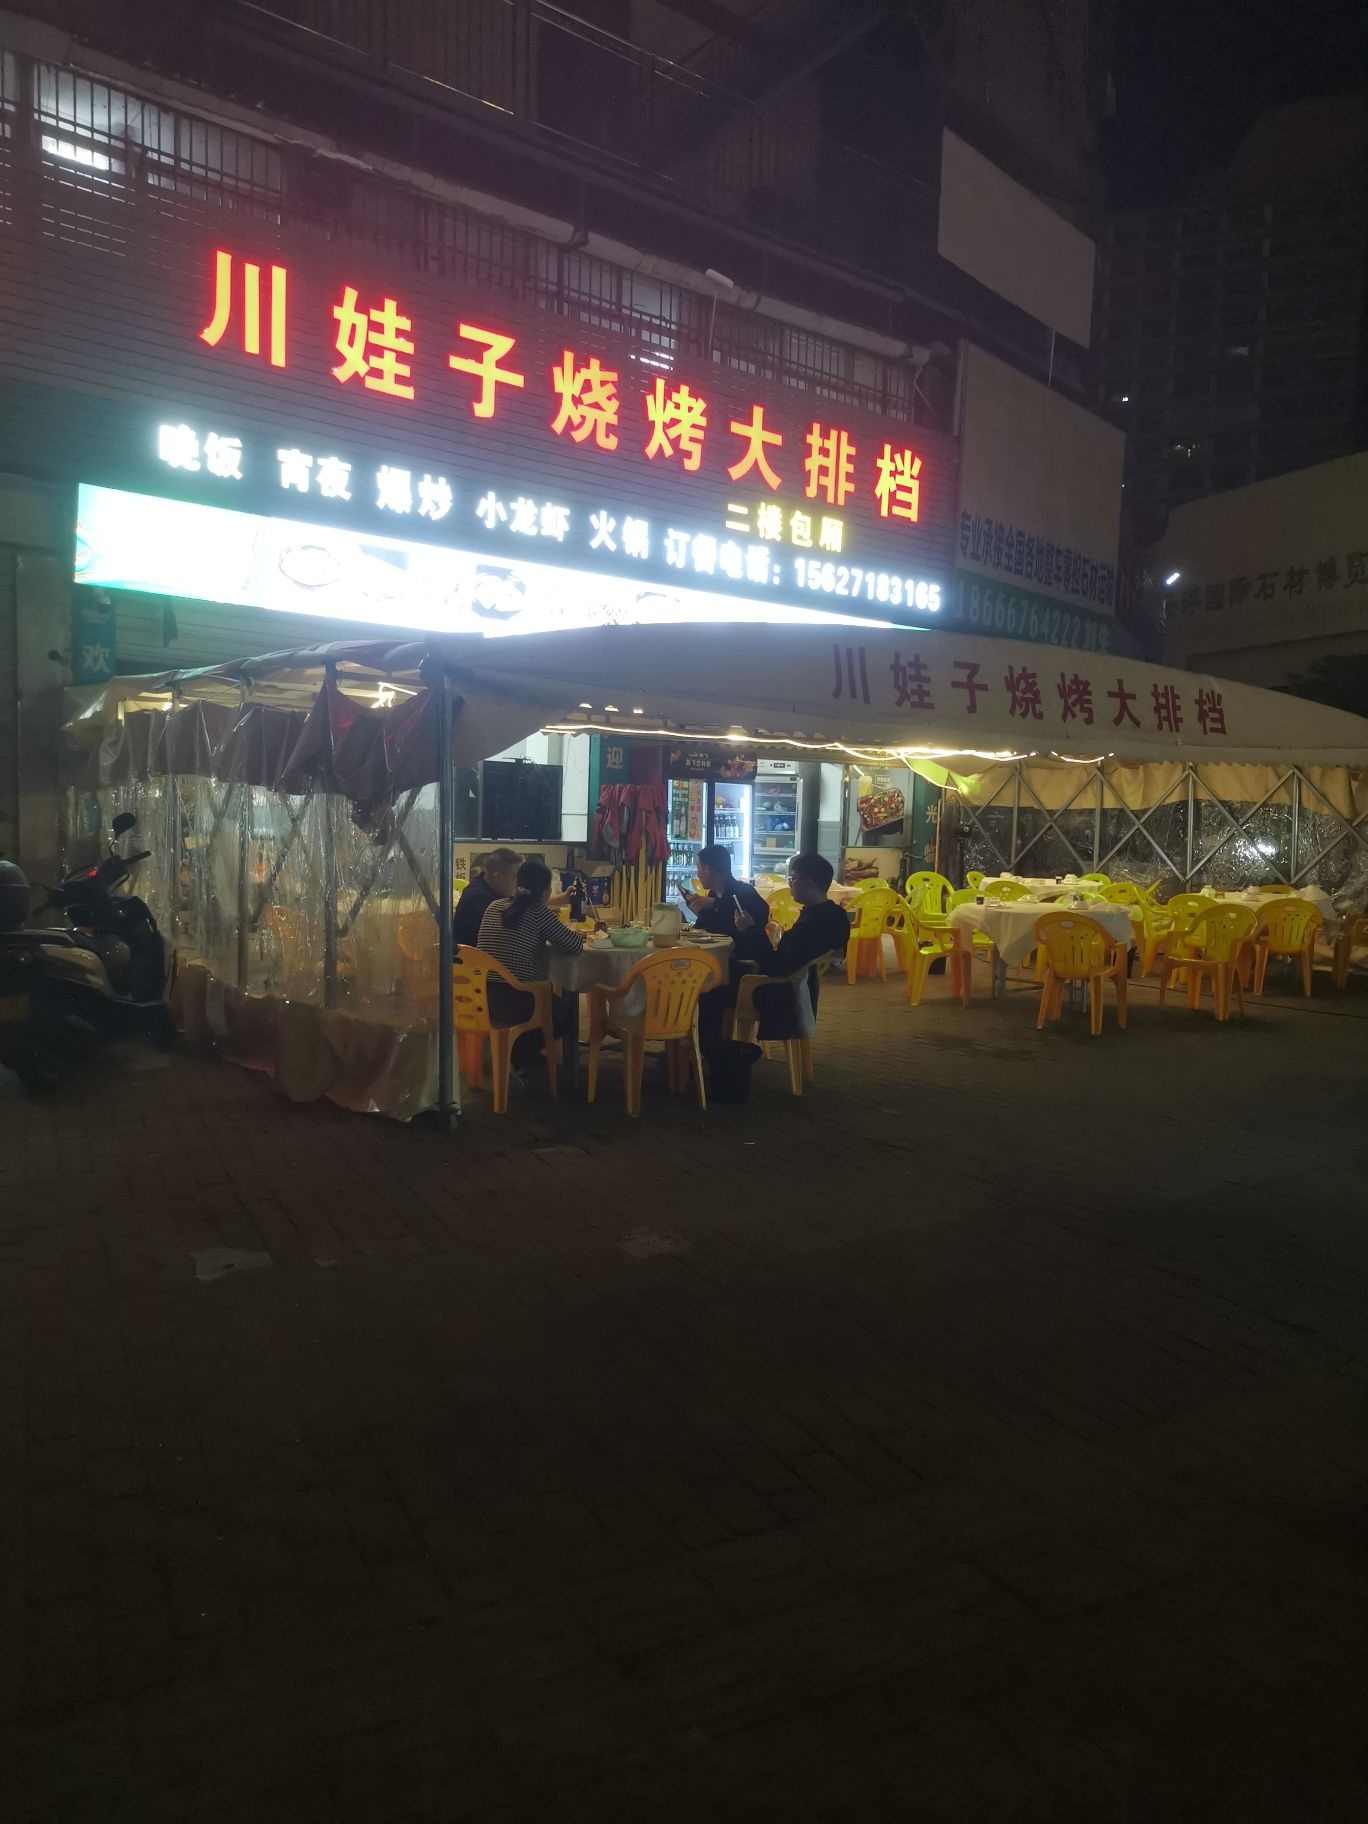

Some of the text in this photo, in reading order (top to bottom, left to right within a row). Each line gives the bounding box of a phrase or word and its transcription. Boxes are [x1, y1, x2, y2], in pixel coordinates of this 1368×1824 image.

[199, 250, 924, 523] 川娃子烧烤大排档
[476, 491, 570, 542] 小龙虾
[589, 510, 650, 559] 火锅
[725, 502, 845, 553] 二楼包厢
[832, 644, 1228, 736] 川娃子烧烤大排档
[606, 746, 624, 770] 迎
